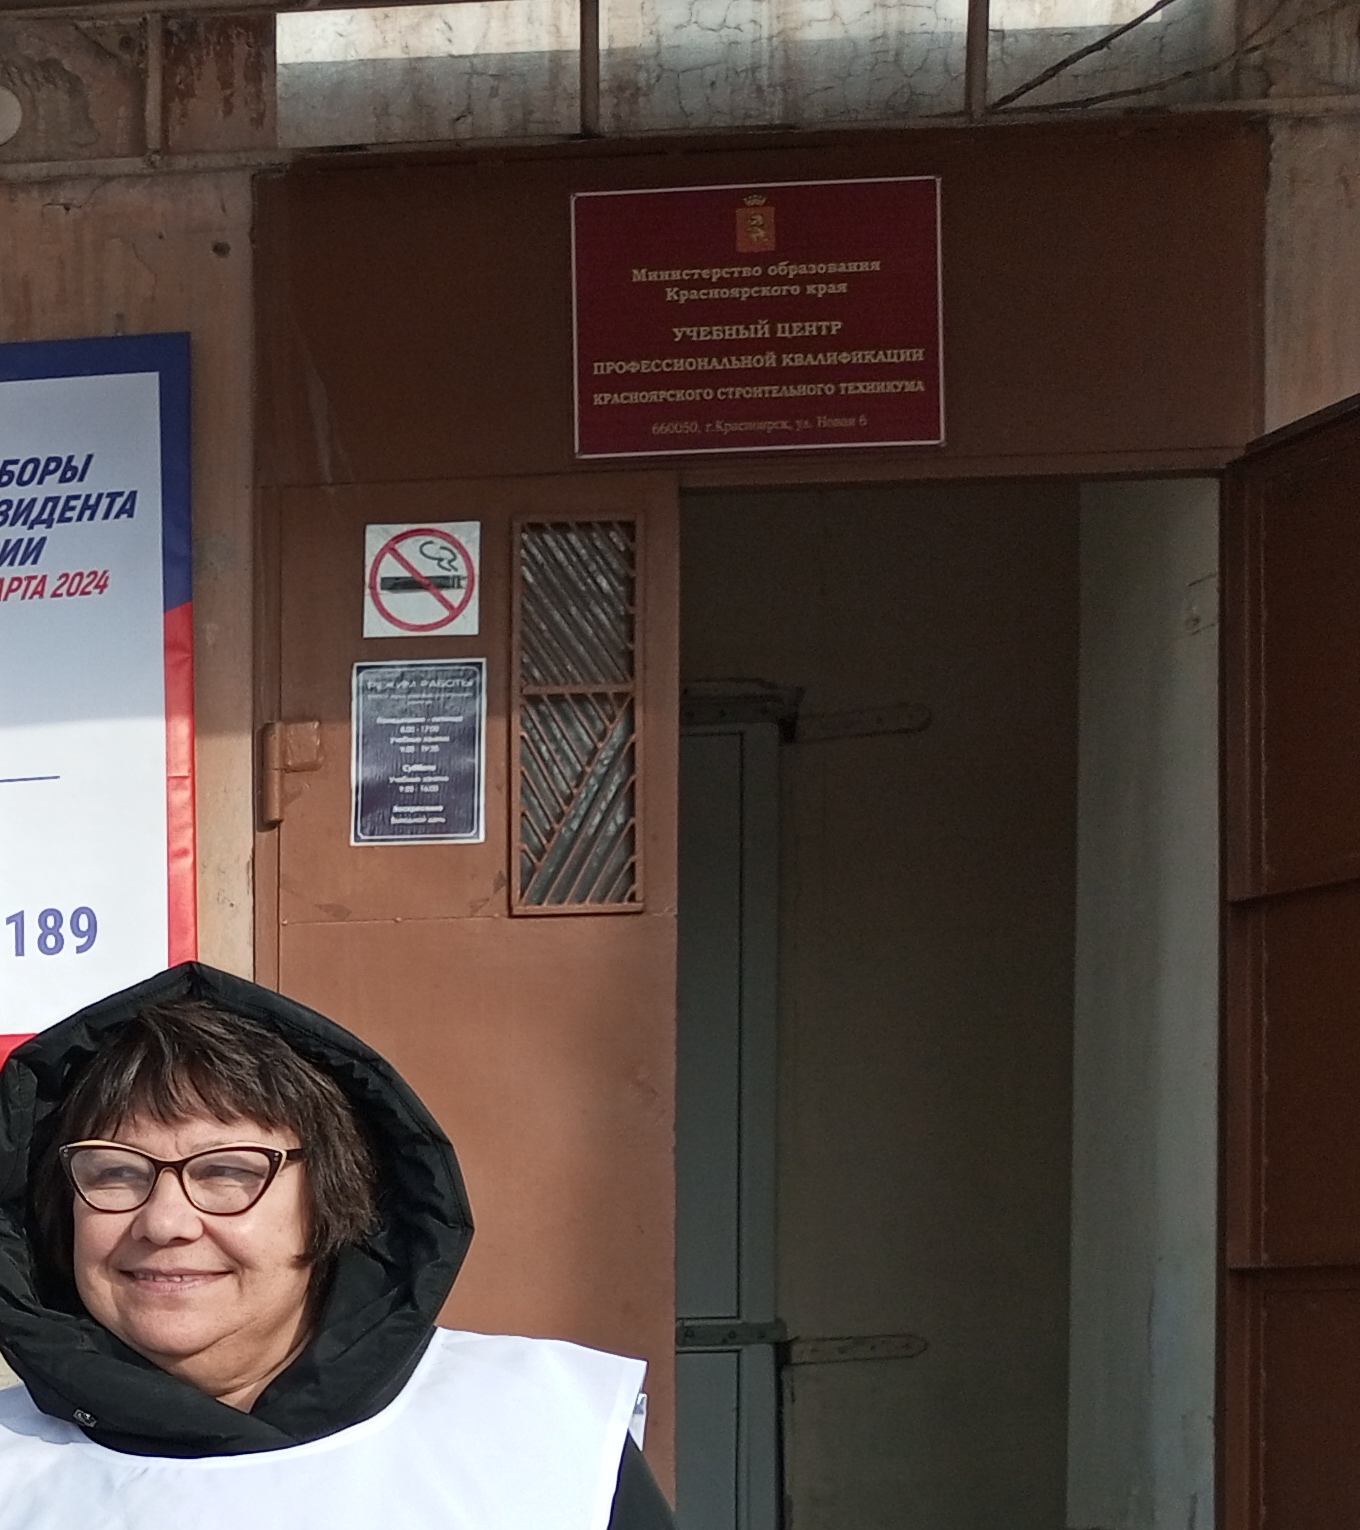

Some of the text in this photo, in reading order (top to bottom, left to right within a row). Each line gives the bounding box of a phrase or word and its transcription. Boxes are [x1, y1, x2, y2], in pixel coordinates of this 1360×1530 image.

[631, 260, 881, 283] Министерство образования
[665, 282, 848, 304] Красноярского края
[672, 319, 843, 342] УЧЕБНЫЙ ЦЕНТР
[593, 348, 926, 375] ПРОФЕССИОНАЛЬНОЙ КВАЛИФИКАЦИИ
[592, 380, 925, 406] КРАСНОЯРСКОГО СТРОИТЕЛЬНОГО ТЕХНИКУМА
[50, 569, 110, 599] 2024
[5, 906, 98, 958] 189
